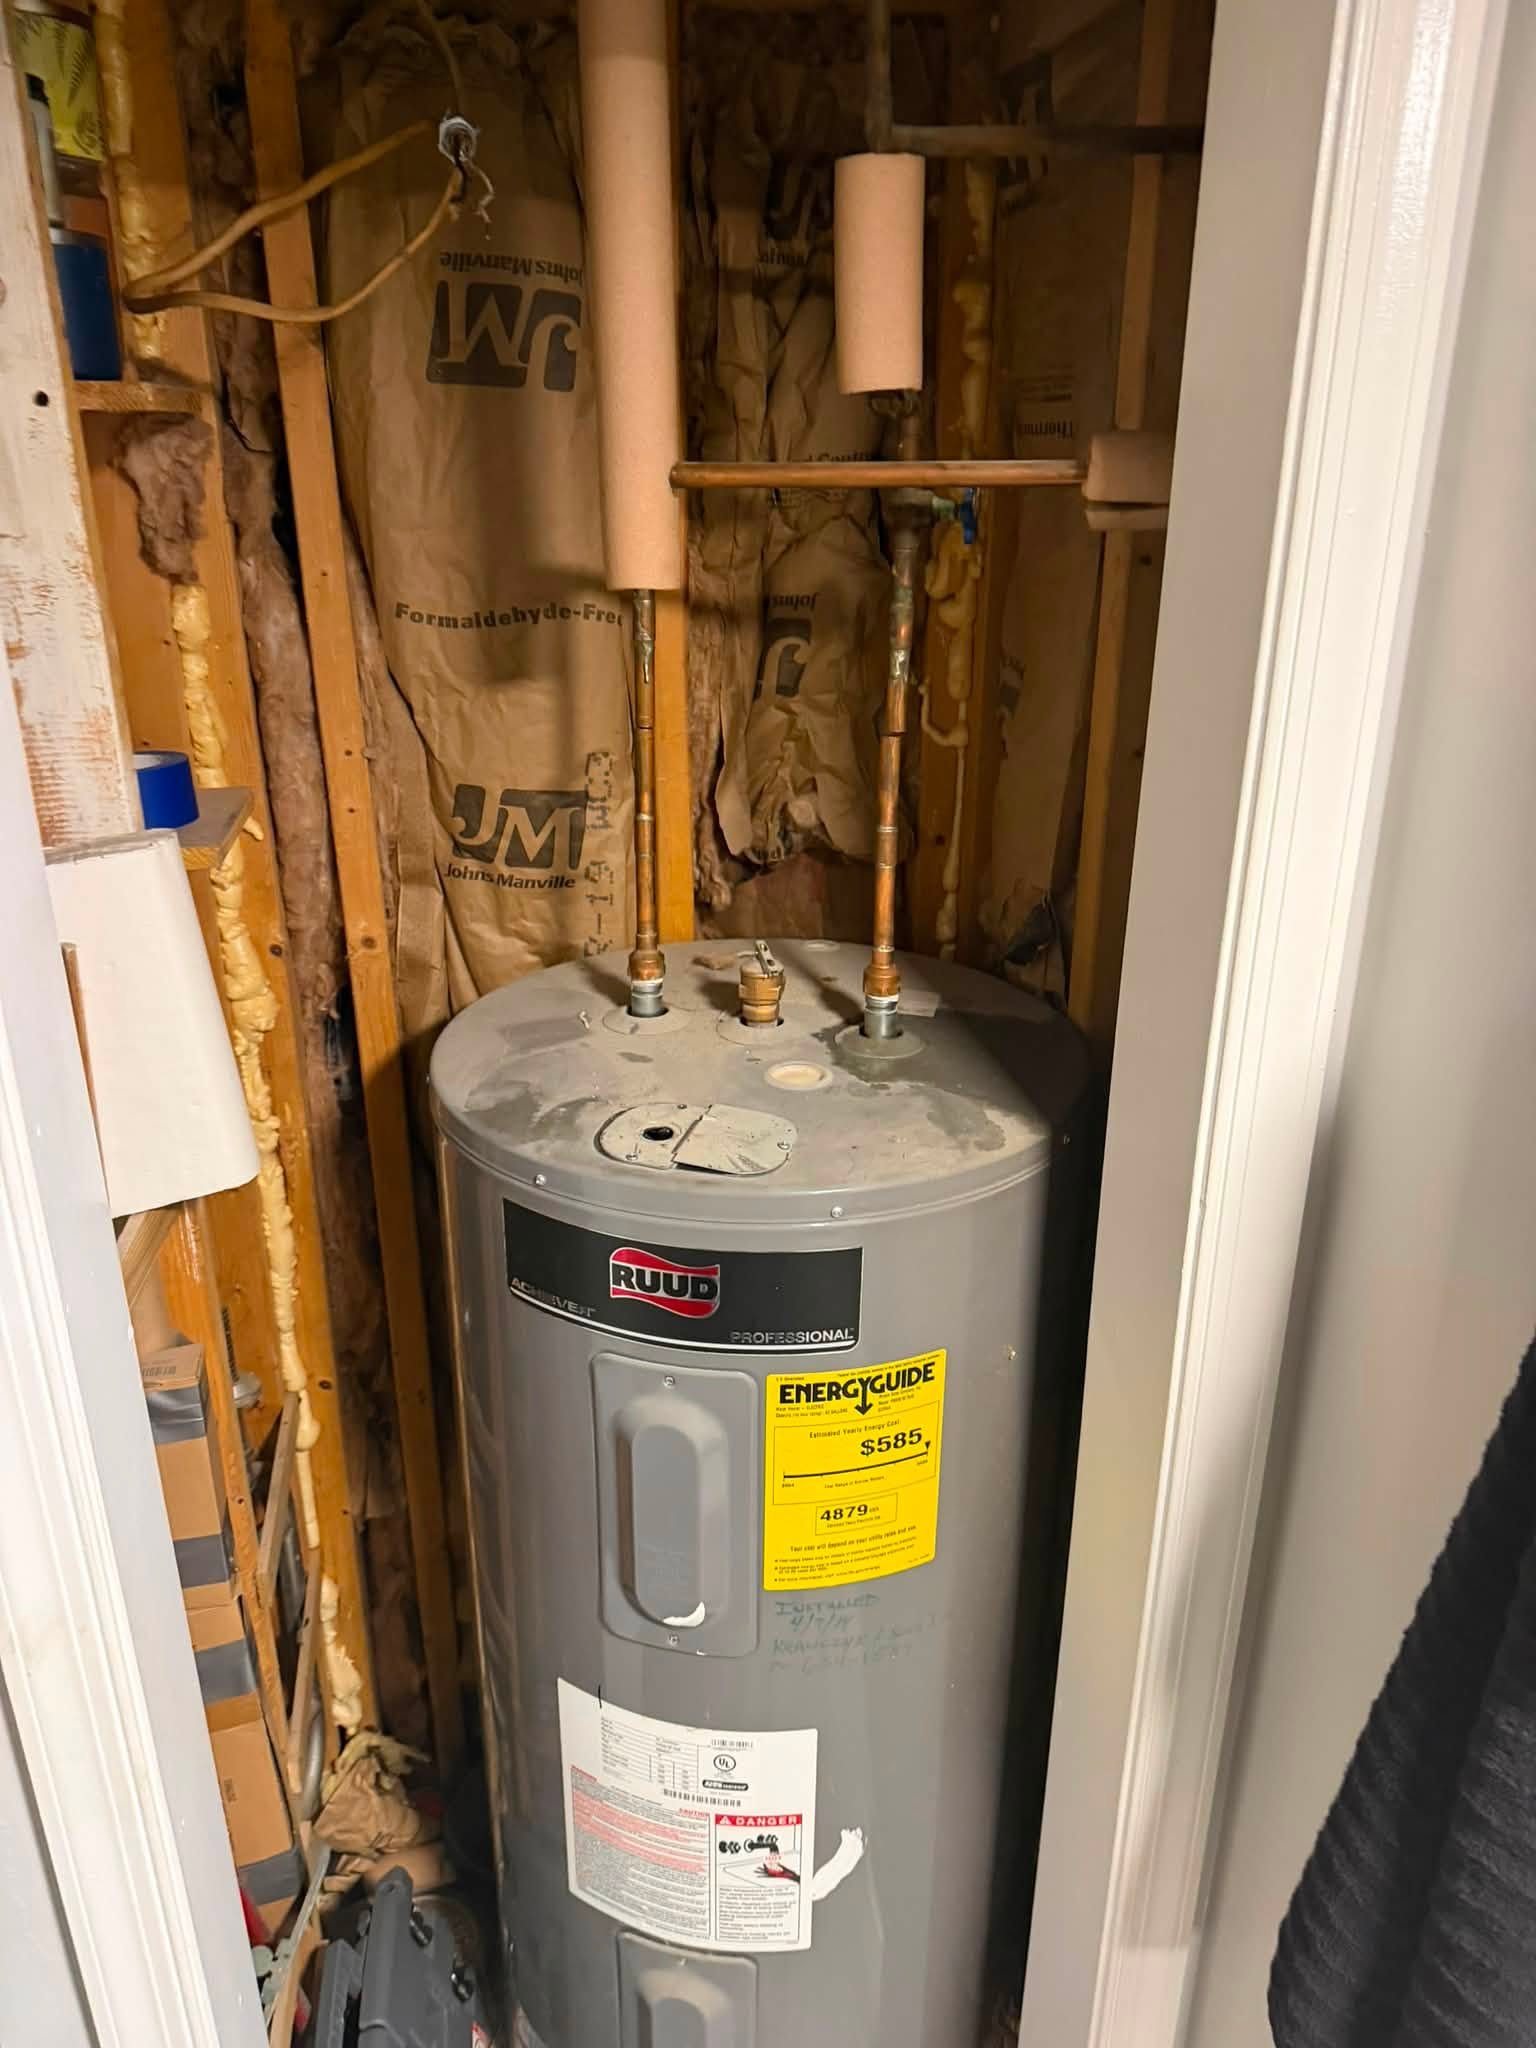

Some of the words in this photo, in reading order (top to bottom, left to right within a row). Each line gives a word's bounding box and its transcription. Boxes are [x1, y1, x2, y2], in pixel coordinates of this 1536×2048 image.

[439, 250, 533, 275] Manville
[452, 783, 590, 870] JM
[445, 863, 494, 883] Johns
[496, 872, 577, 889] Manville
[611, 1262, 719, 1301] RUUD
[779, 1361, 936, 1405] ENERGYGUIDE
[864, 1422, 885, 1432] Energy
[860, 1427, 923, 1457] $585
[820, 1503, 869, 1522] 4879
[735, 1815, 797, 1826] DANGER
